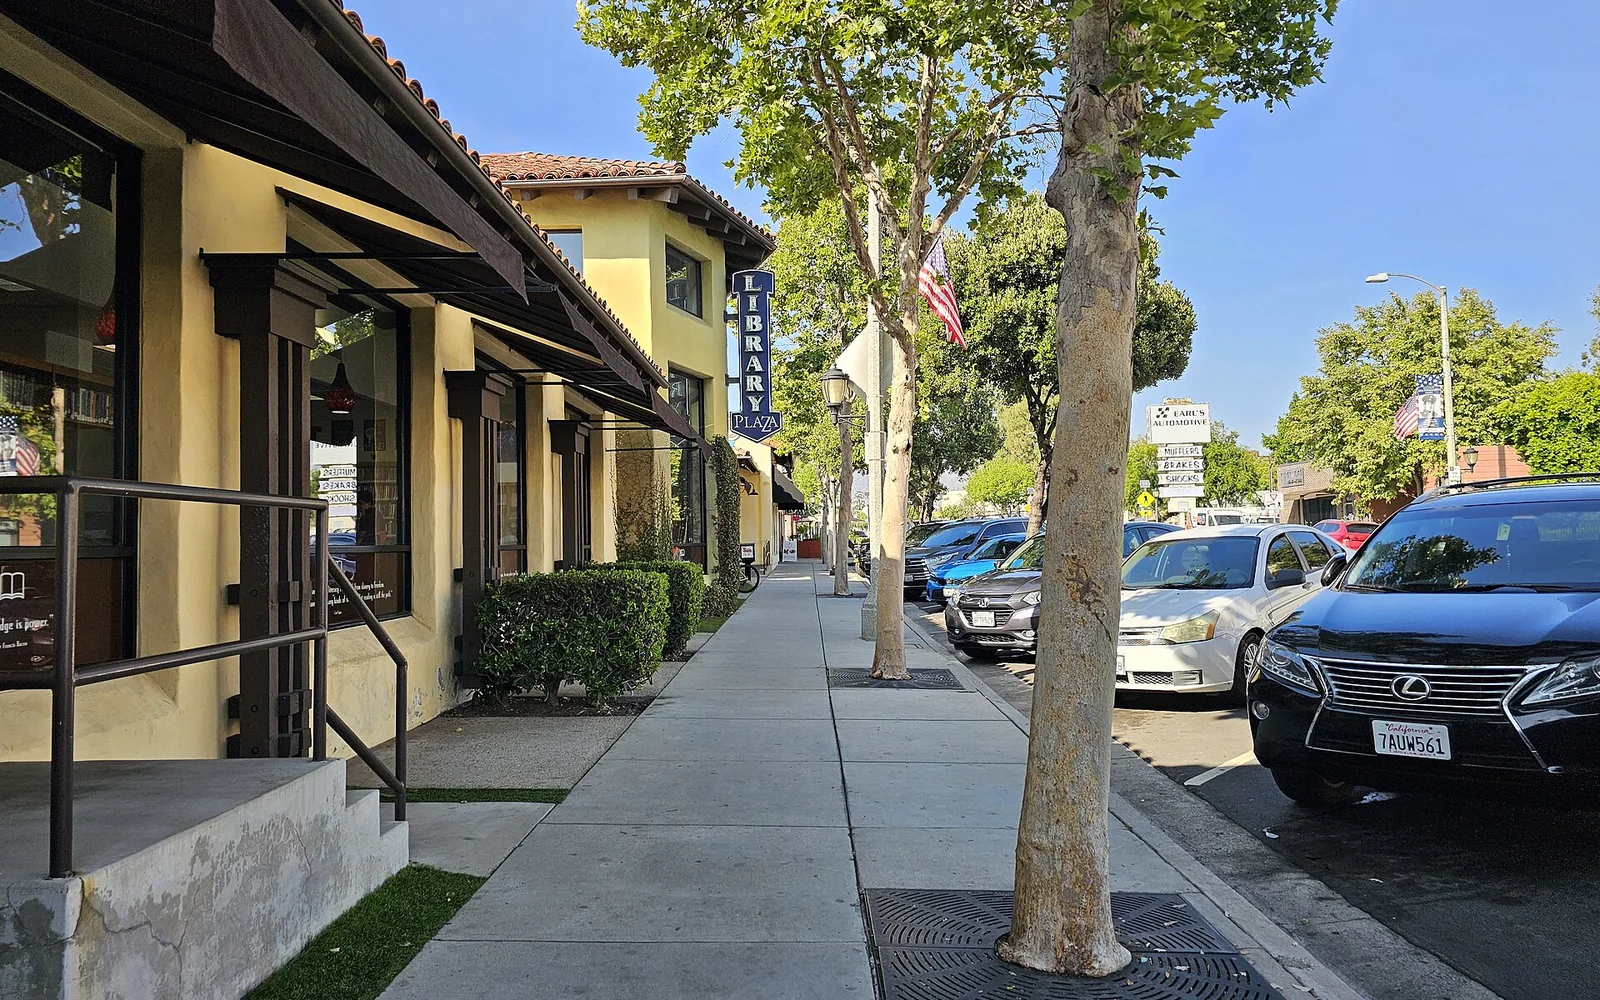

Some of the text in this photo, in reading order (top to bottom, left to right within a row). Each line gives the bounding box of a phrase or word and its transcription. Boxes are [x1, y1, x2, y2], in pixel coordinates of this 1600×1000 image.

[743, 274, 765, 412] LIBRARY
[734, 414, 779, 432] PLAZA
[1153, 419, 1208, 427] AUTOMOTIVE
[1164, 447, 1200, 455] MUFFLERS
[1163, 461, 1200, 469] BRAKES
[1165, 474, 1200, 483] SHOCKS
[15, 619, 23, 630] is
[1387, 723, 1430, 735] California
[1378, 732, 1446, 755] 7AUW561
